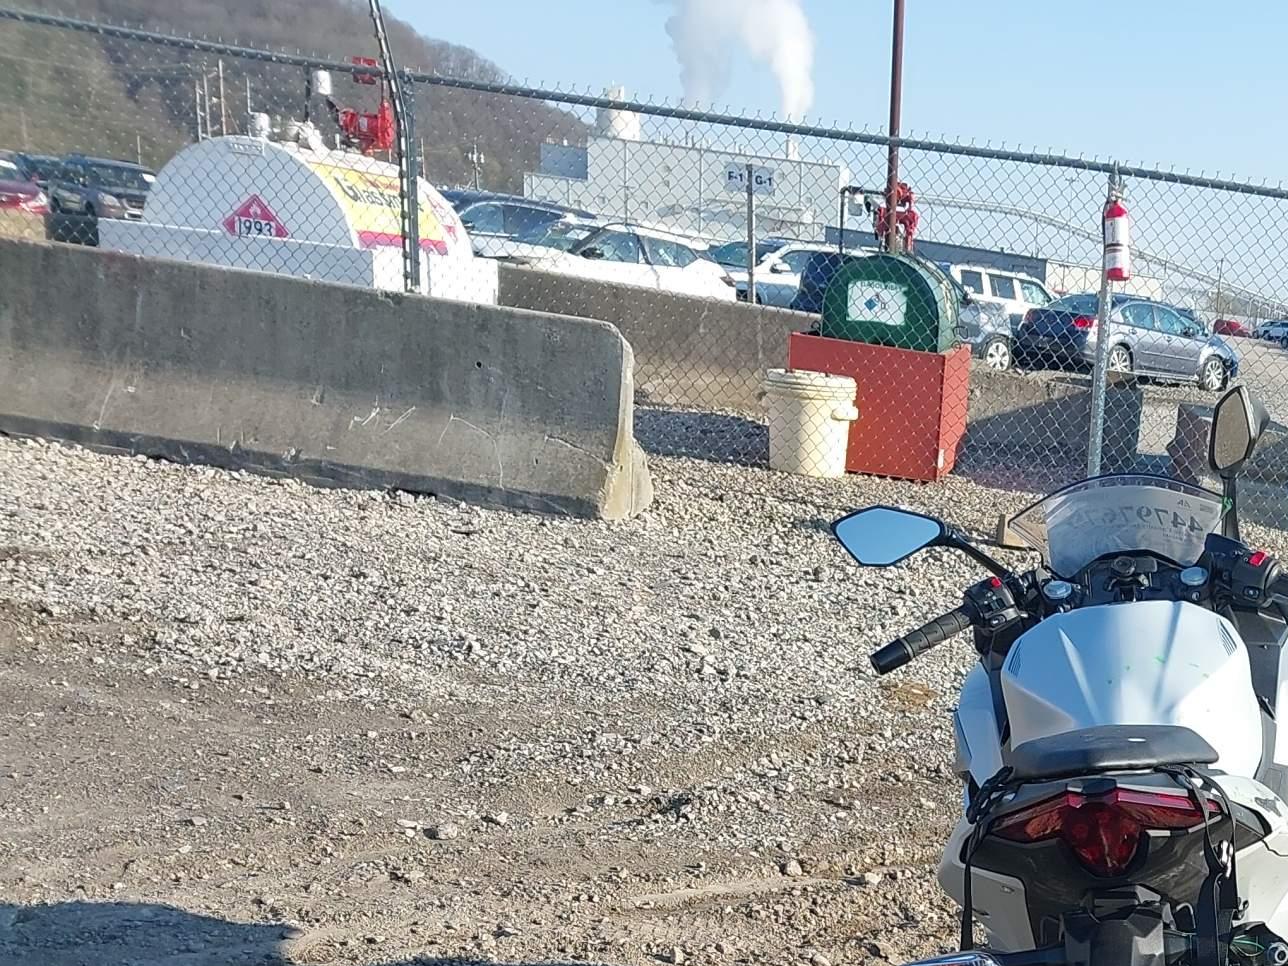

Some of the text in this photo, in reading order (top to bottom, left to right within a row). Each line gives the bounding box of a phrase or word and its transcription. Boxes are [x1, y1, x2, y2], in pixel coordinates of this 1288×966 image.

[728, 171, 743, 182] F-1
[755, 175, 772, 186] G-1
[238, 217, 273, 237] 1993
